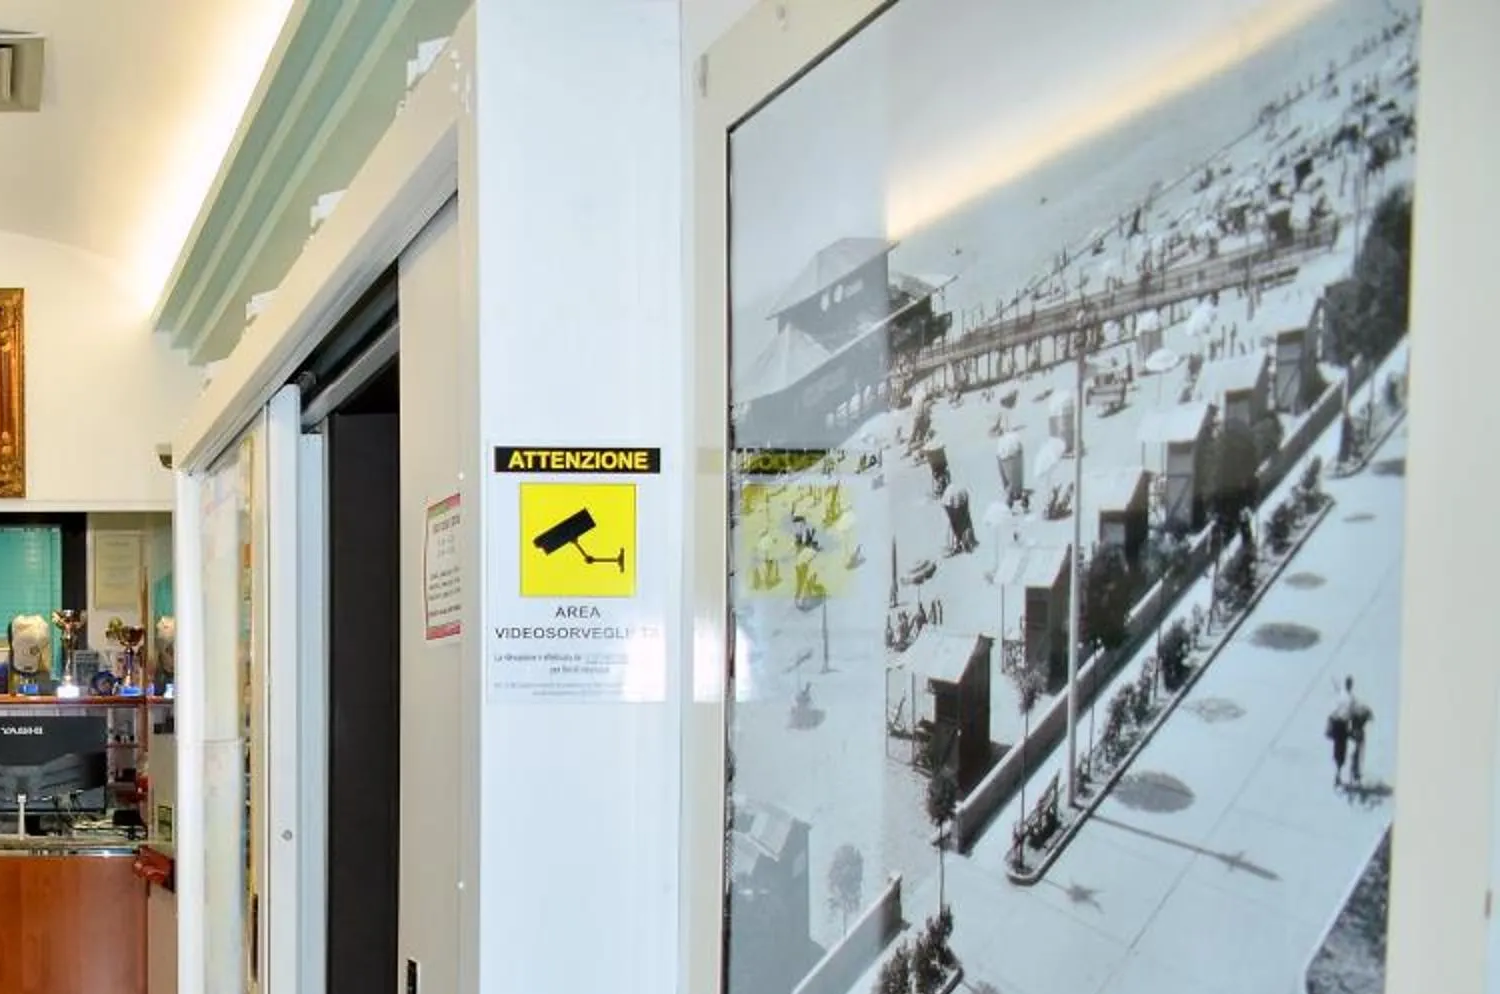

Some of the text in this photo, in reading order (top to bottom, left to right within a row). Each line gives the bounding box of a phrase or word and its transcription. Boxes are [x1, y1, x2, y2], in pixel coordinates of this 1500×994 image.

[507, 450, 650, 470] ATTENZIONE
[555, 606, 601, 618] AREA
[494, 627, 660, 639] VIDEOSORVEGLITA
